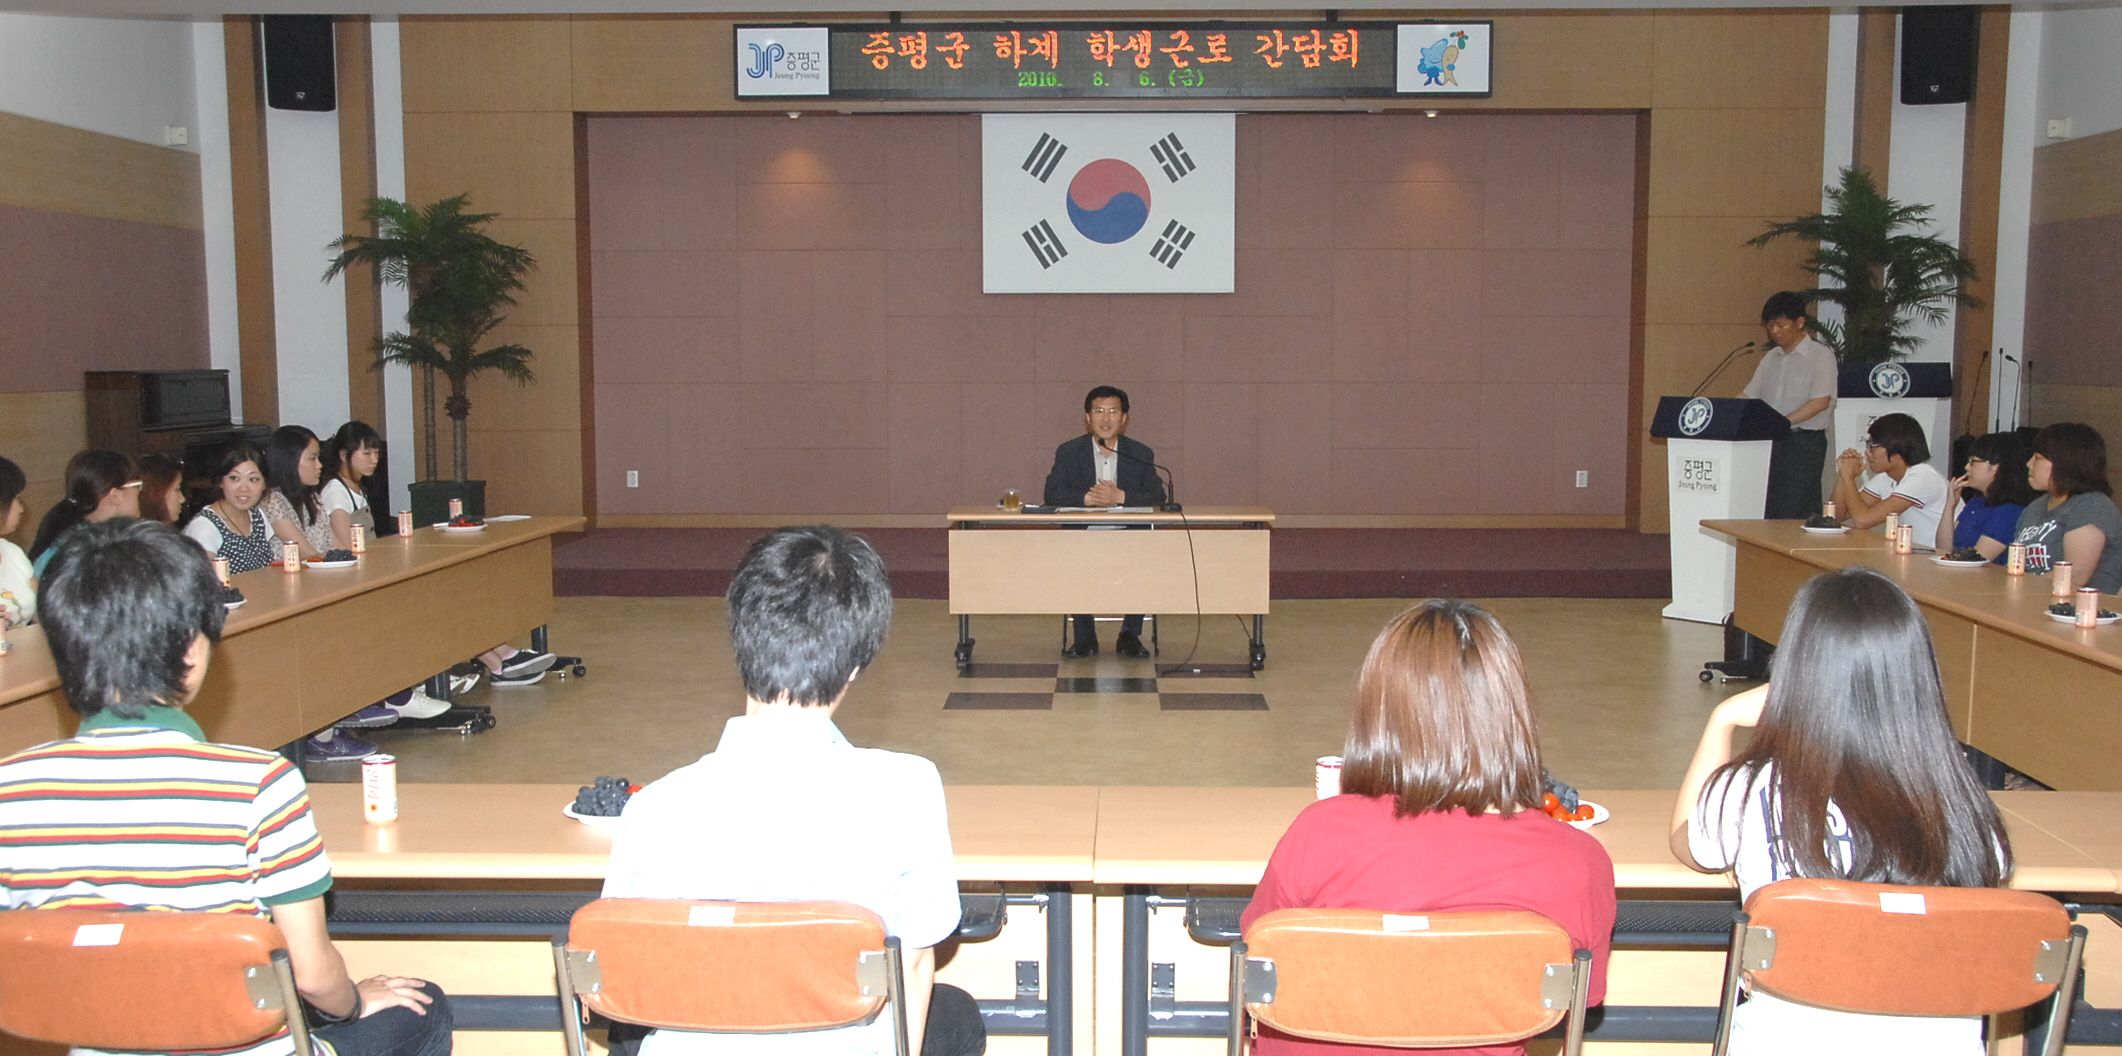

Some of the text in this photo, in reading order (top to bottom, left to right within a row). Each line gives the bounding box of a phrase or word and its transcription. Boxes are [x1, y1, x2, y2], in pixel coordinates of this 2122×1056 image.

[861, 31, 970, 70] 증평군
[1086, 29, 1233, 69] 학생근로
[1253, 29, 1359, 68] 간담회
[786, 52, 820, 71] 증평군
[1018, 71, 1063, 87] 2010.
[1168, 69, 1205, 87] (금)
[1684, 460, 1713, 481] 증평군
